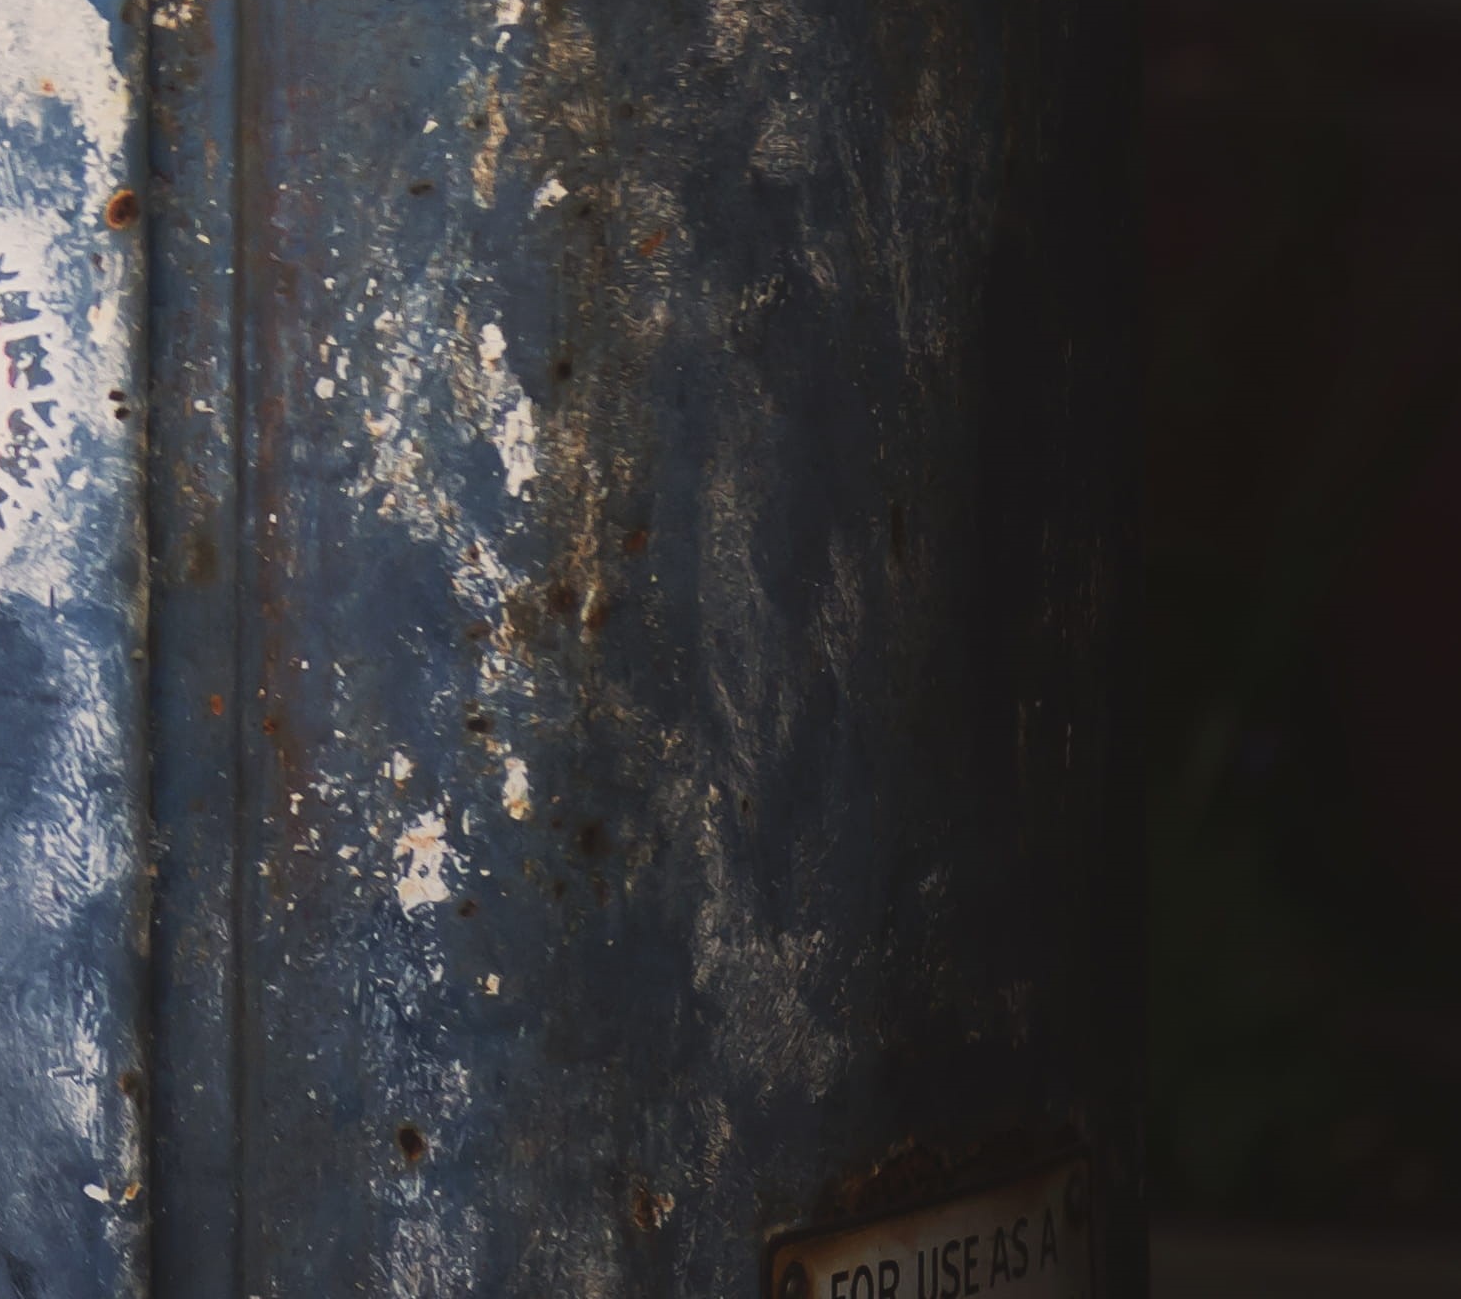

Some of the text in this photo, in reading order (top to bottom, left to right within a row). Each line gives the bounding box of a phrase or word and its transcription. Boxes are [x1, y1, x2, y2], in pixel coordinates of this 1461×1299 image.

[917, 1234, 981, 1299] USE
[988, 1216, 1029, 1289] AS
[1039, 1208, 1059, 1271] A
